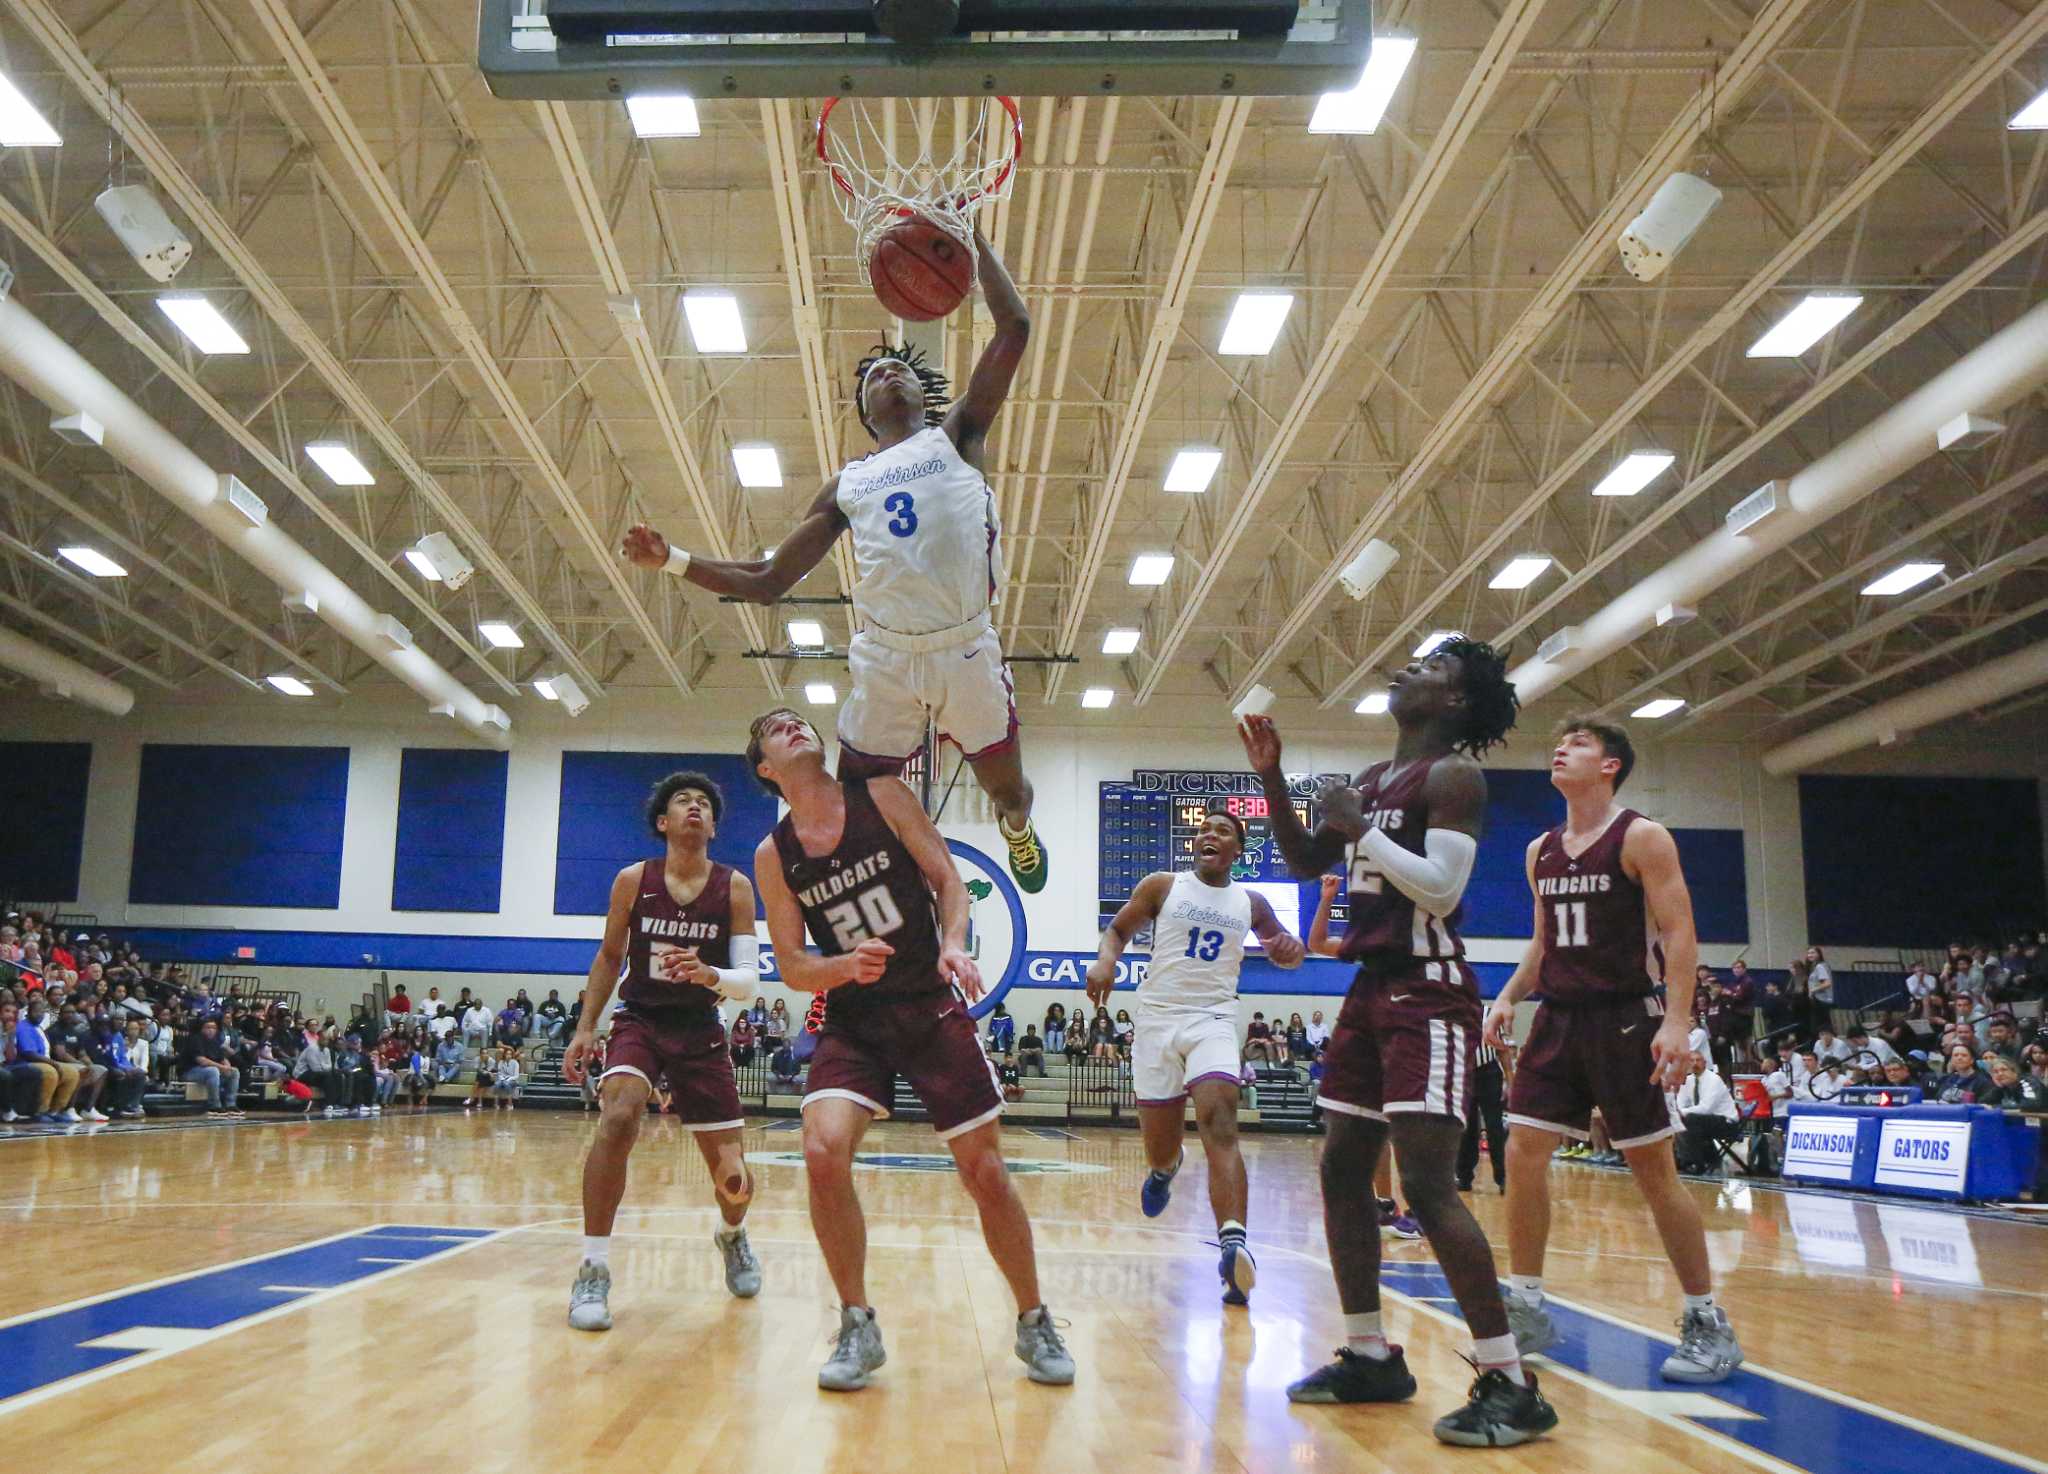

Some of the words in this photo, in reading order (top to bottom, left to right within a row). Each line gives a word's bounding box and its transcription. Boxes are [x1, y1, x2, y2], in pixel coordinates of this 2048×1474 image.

[852, 457, 946, 504] Dickinson
[884, 491, 919, 538] 3
[1136, 771, 1334, 796] DICKINO
[1175, 798, 1207, 807] GATORS
[1182, 807, 1206, 826] 45
[798, 850, 891, 908] WILDCATS
[1537, 873, 1611, 896] WILDCATS
[641, 916, 719, 939] WILDCATS
[823, 884, 904, 952] 20
[1554, 901, 1590, 947] 11
[1184, 926, 1225, 962] 13
[1028, 957, 1151, 985] GAOR
[1791, 1131, 1855, 1154] DICKINSON
[1893, 1137, 1950, 1162] GATORS
